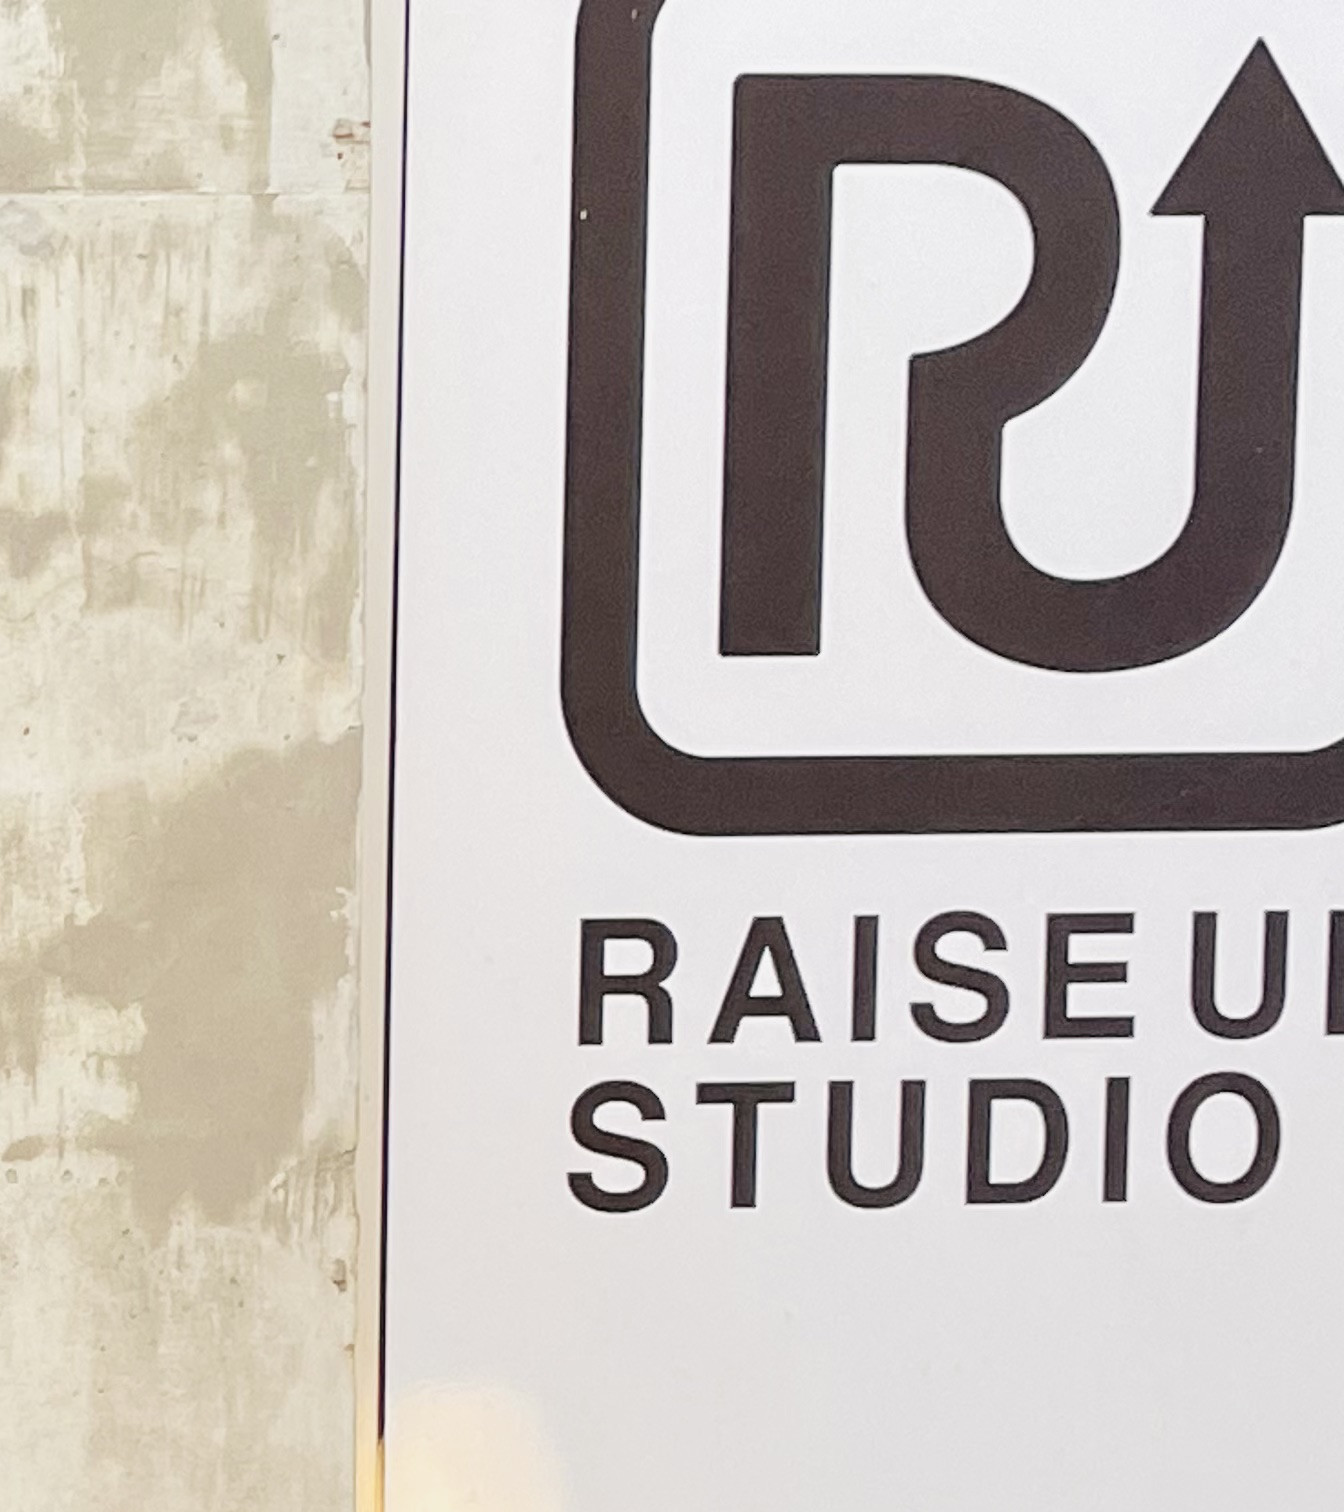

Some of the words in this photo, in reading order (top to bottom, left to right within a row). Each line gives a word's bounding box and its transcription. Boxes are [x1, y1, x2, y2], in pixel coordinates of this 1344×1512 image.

[579, 911, 1134, 1046] RAISE
[1191, 910, 1344, 1039] U
[567, 1072, 1280, 1213] STUDIO
